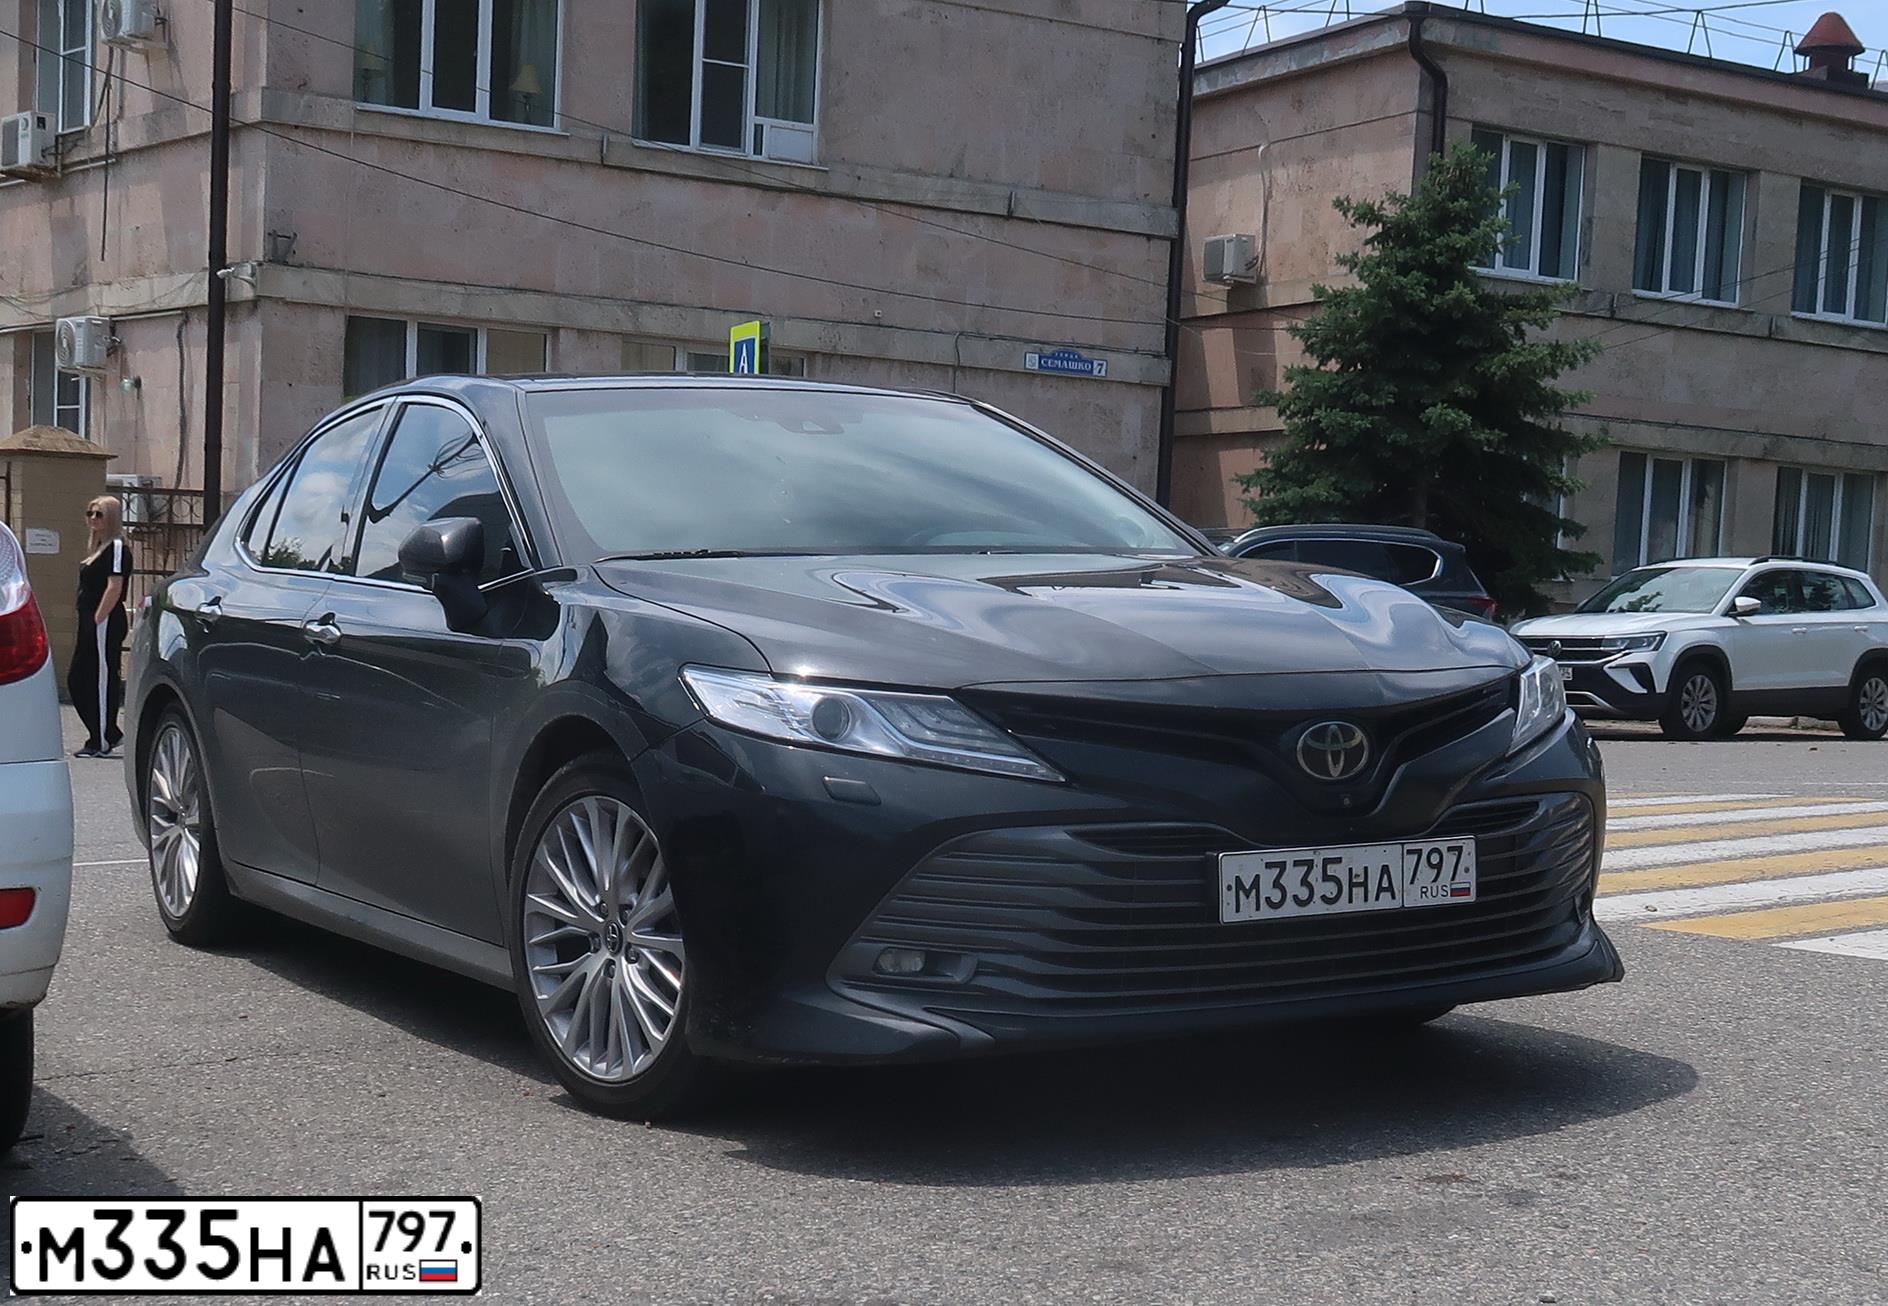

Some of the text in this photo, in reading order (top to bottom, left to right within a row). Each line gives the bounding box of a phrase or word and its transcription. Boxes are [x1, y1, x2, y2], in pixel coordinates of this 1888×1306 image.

[1041, 359, 1104, 374] СЕМАШКО 7
[1406, 846, 1463, 885] 797
[1420, 885, 1448, 898] RUS
